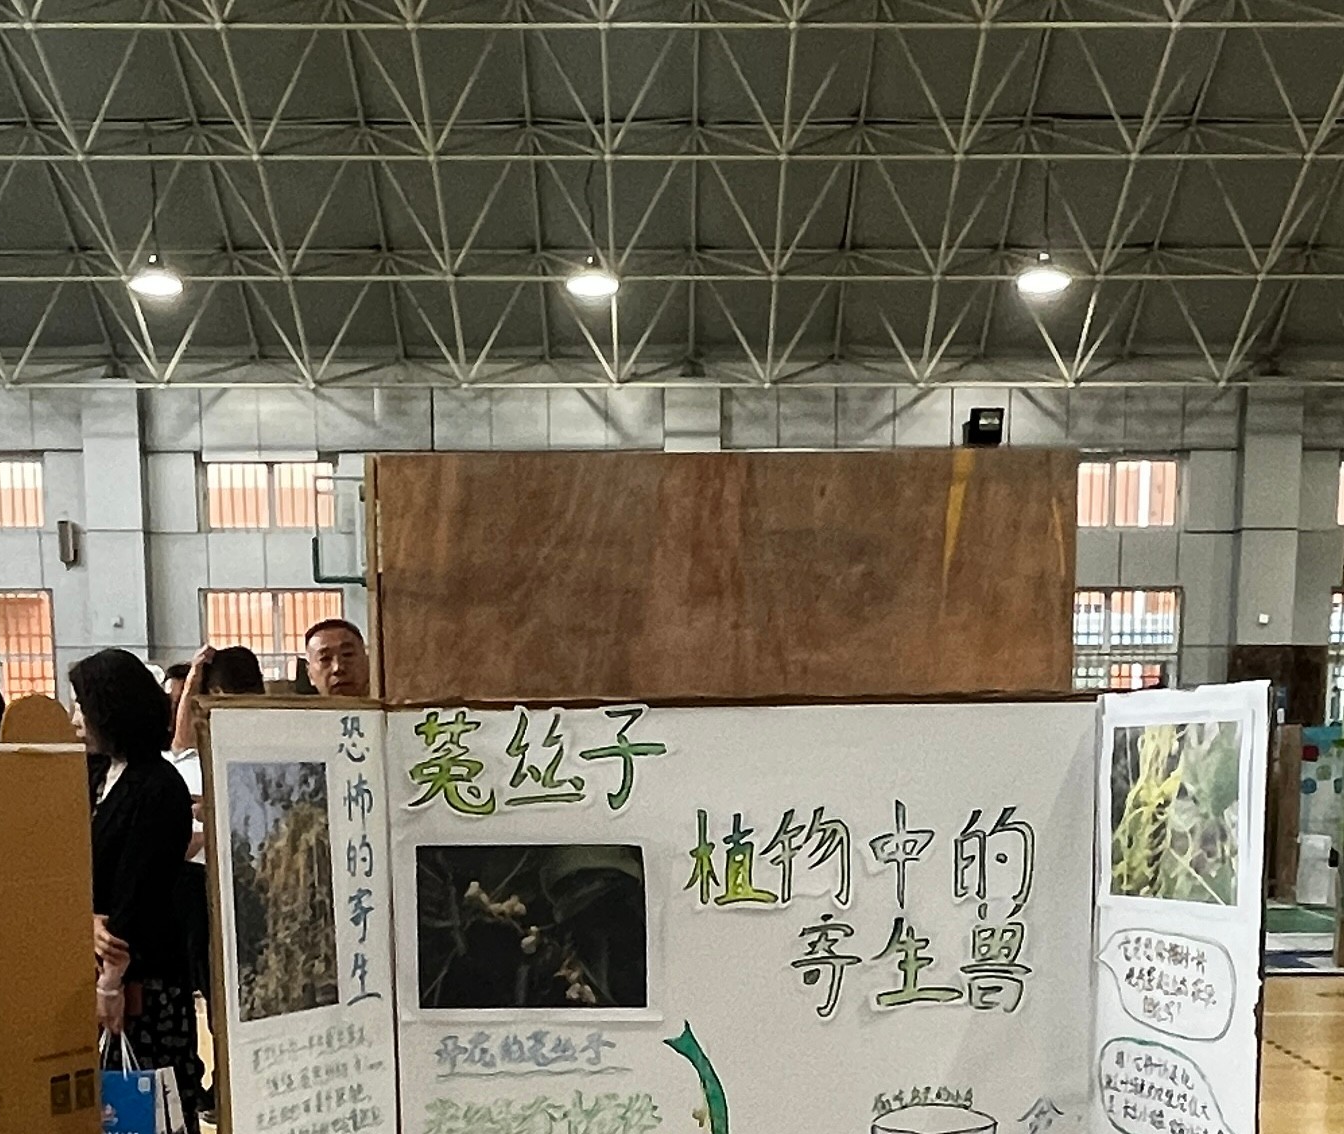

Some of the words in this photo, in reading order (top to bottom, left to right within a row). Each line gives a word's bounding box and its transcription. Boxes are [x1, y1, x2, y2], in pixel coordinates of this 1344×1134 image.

[409, 709, 668, 815] 菟丝子
[338, 714, 383, 1008] 恐怖的寄生
[682, 800, 1036, 908] 植物中的
[790, 902, 1033, 1020] 寄生兽
